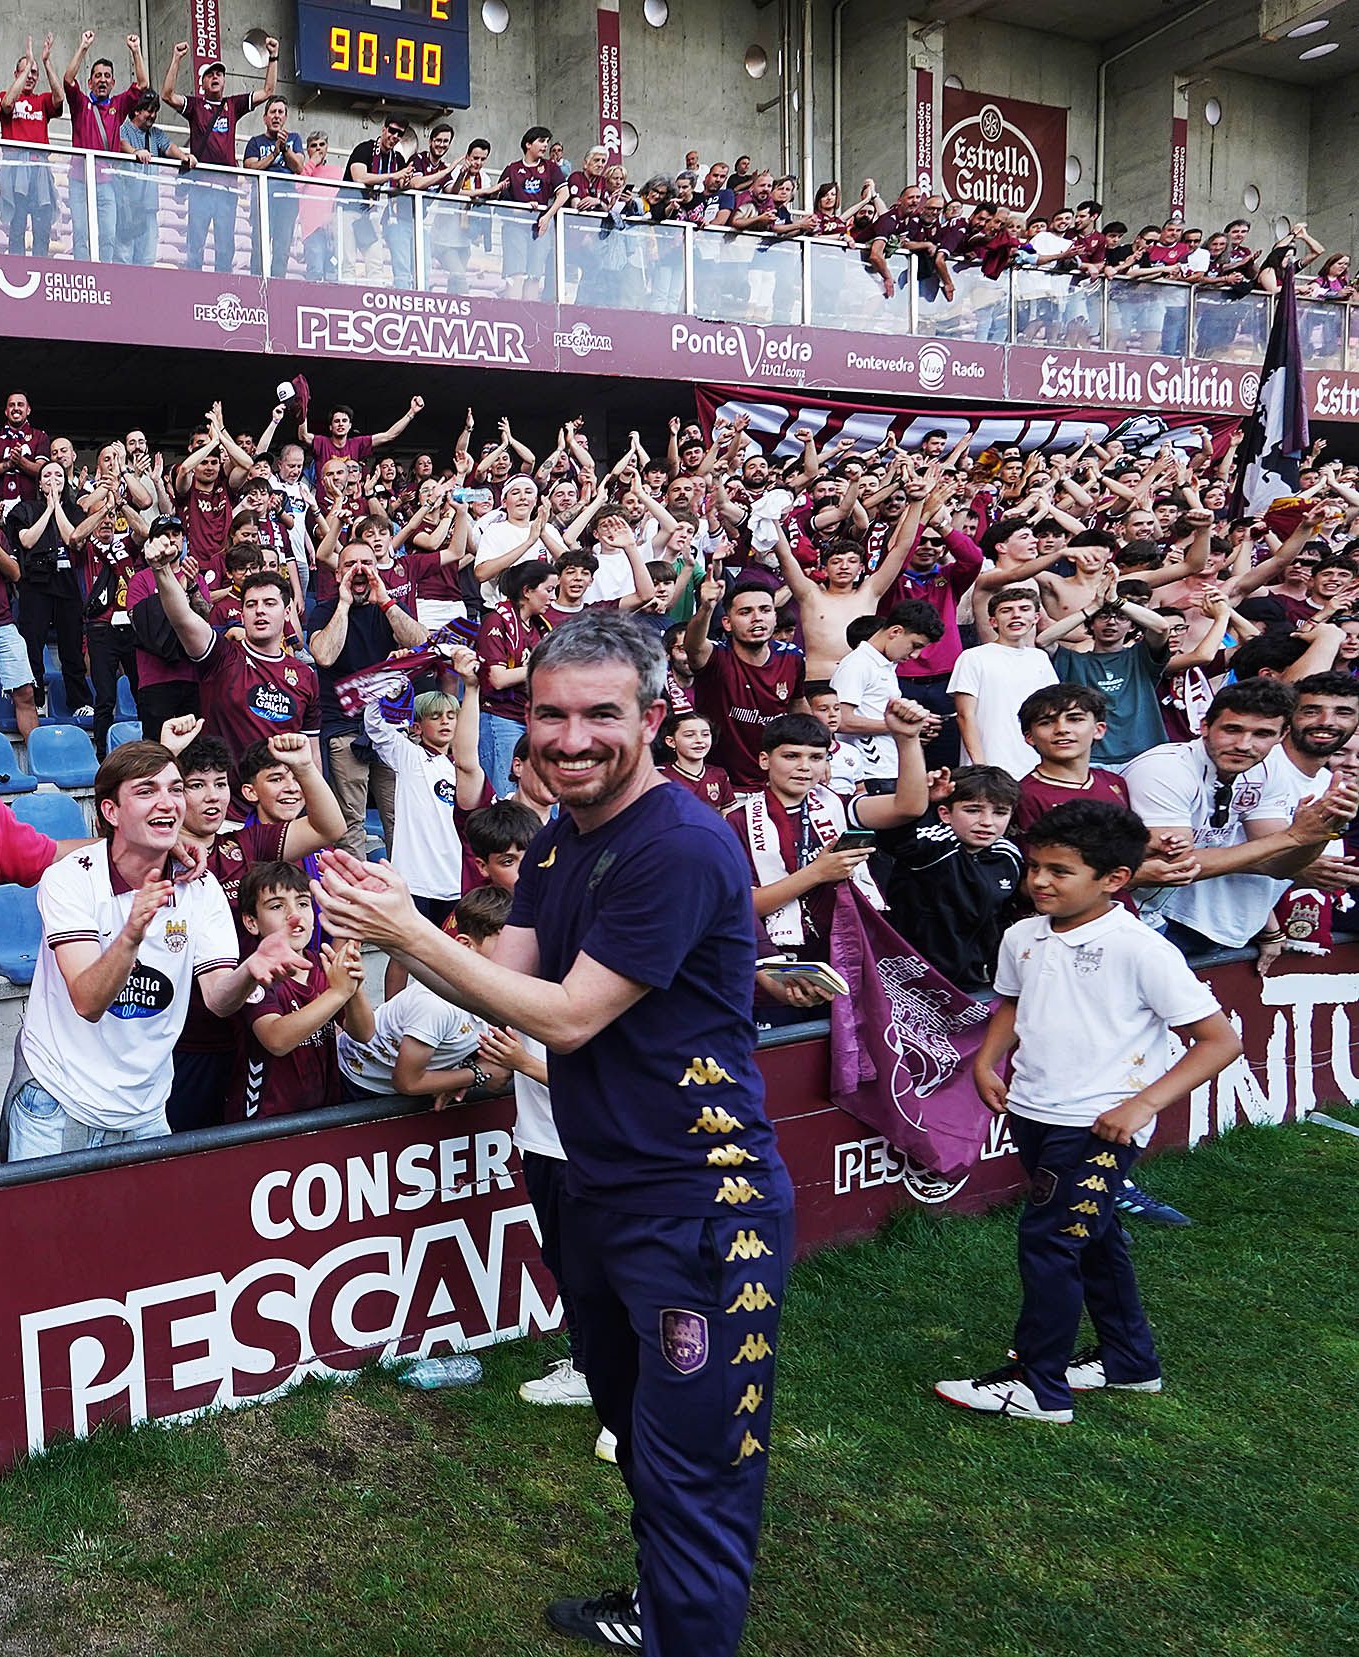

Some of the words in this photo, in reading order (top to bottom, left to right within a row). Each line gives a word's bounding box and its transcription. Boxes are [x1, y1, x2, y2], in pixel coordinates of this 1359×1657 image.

[600, 45, 611, 119] Deputación
[610, 46, 619, 120] Pontevedra
[917, 102, 926, 168] Deputación
[924, 102, 932, 169] Pontevedra
[952, 135, 1030, 178] Estrella
[956, 168, 1026, 208] Galicia
[44, 272, 96, 290] GALICIA
[45, 286, 112, 306] SAUDABLE
[194, 303, 268, 327] PESCAMAR
[362, 291, 472, 316] CONSERVAS
[296, 305, 531, 365] PESCAMAR
[553, 331, 613, 351] PESCAMAR
[847, 351, 915, 373] Pontevedra
[951, 361, 985, 379] Radio
[1038, 353, 1142, 403] Estrella
[1146, 361, 1234, 409] Galicia
[114, 987, 157, 1007] alicia
[125, 973, 160, 992] rella
[250, 1128, 522, 1240] CONSER
